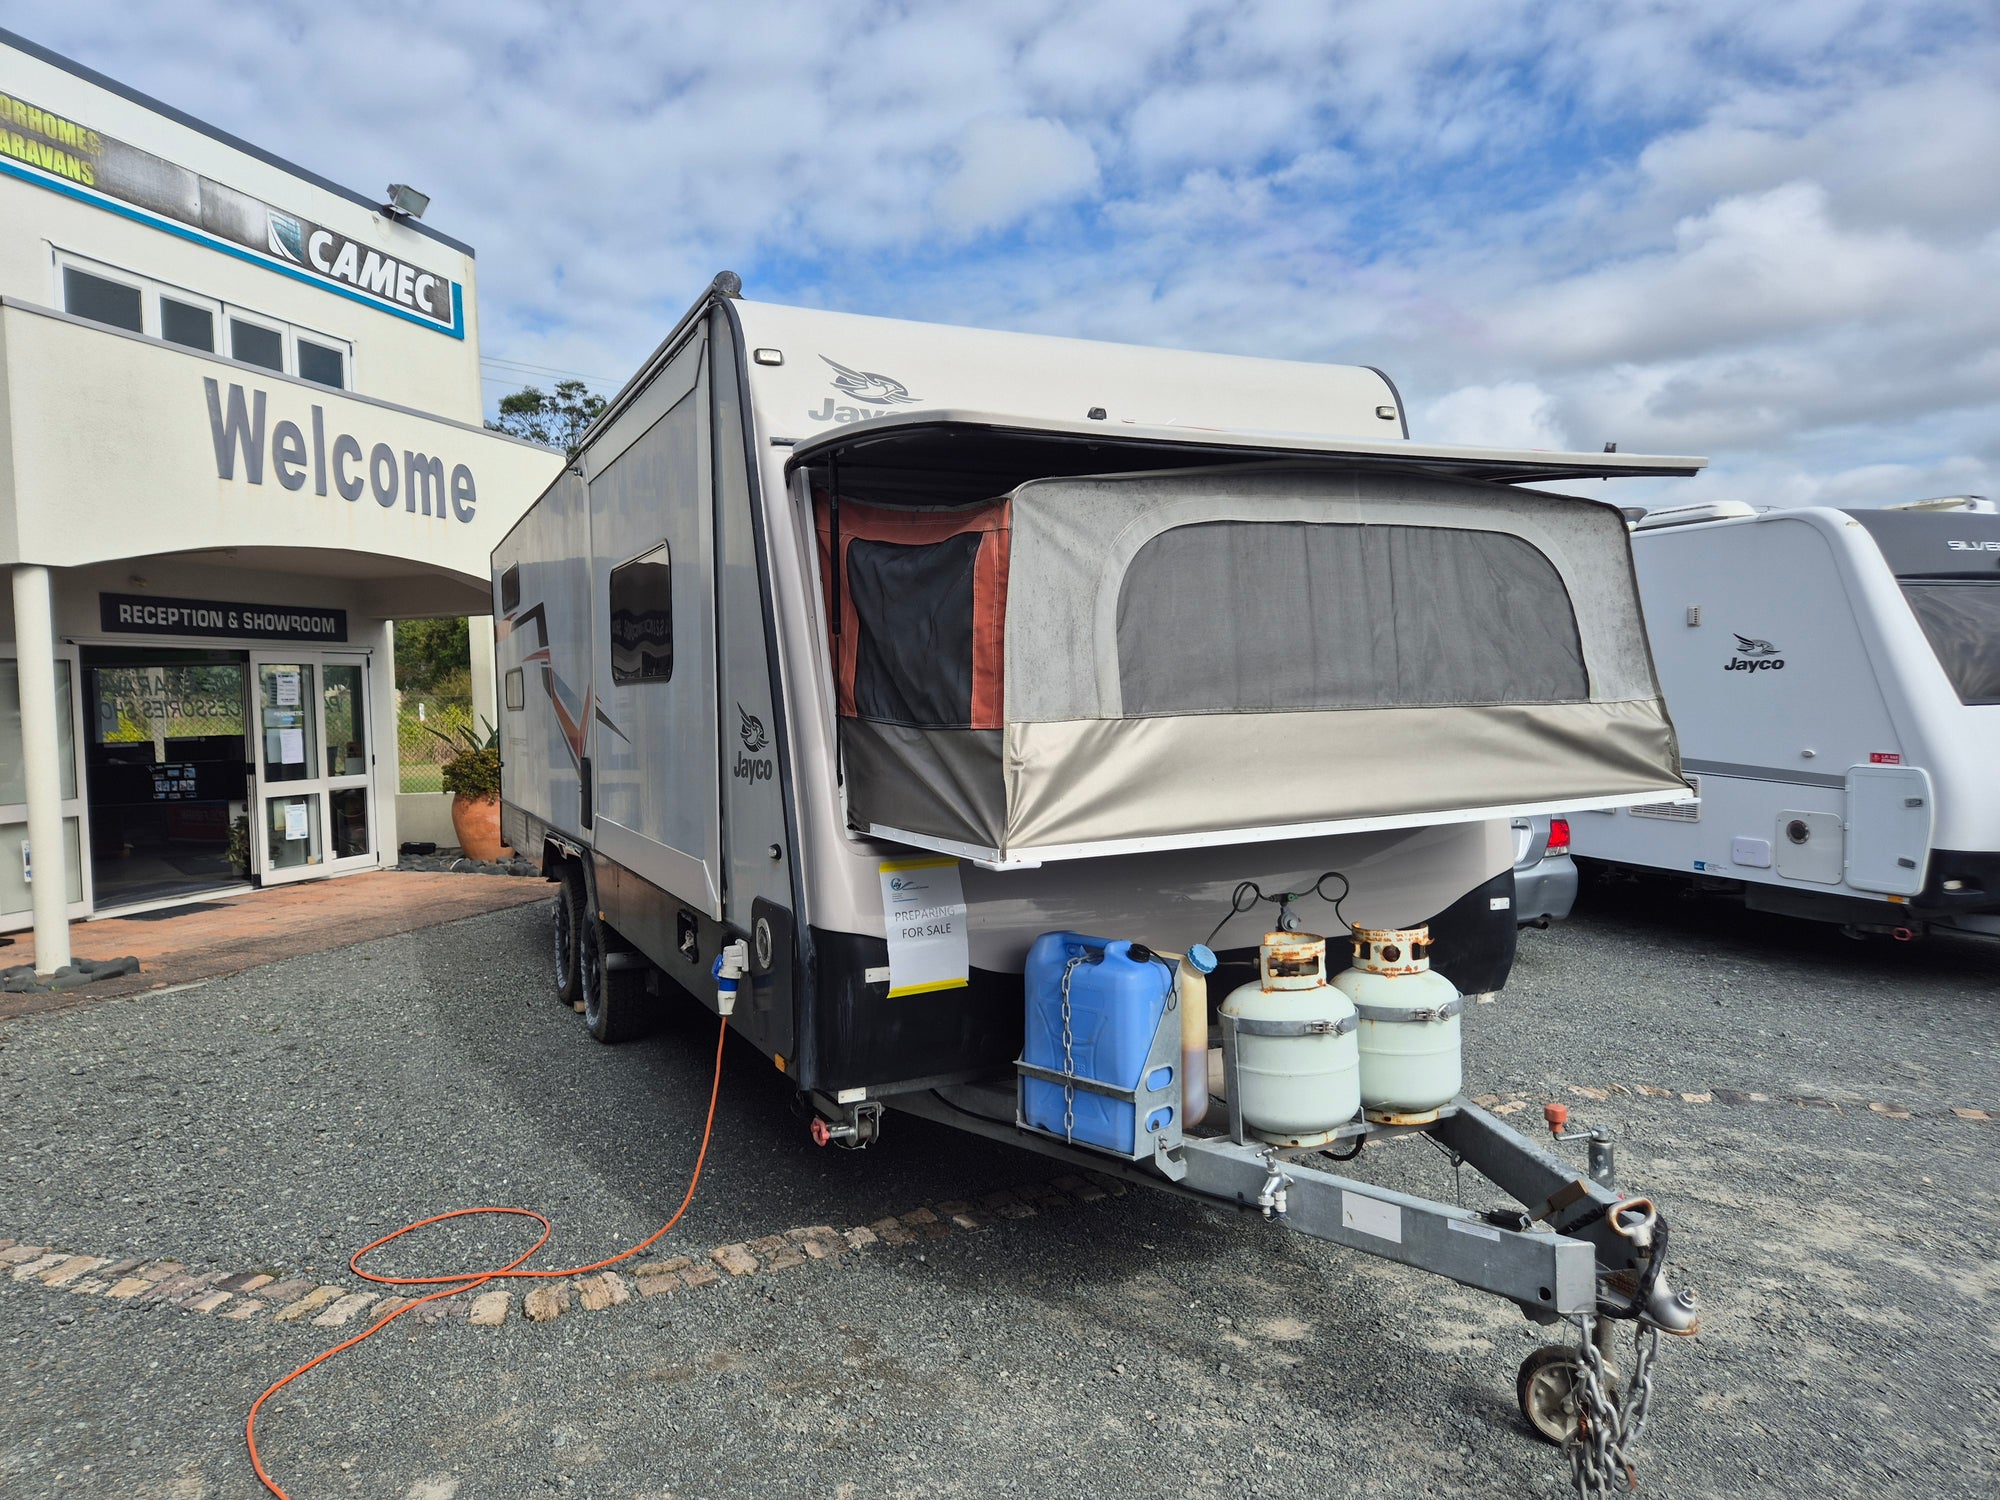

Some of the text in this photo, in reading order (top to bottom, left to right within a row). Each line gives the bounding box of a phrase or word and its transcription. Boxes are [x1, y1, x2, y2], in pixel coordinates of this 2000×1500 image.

[309, 230, 435, 312] CAMEC
[203, 376, 477, 523] Welcome
[1947, 540, 2000, 551] SILVE
[118, 603, 336, 634] RECEPTION & SHOWROOM
[1724, 657, 1785, 674] Jayco
[733, 750, 773, 786] Jayco
[894, 906, 955, 922] PREPARING
[902, 923, 952, 939] FOR SALE
